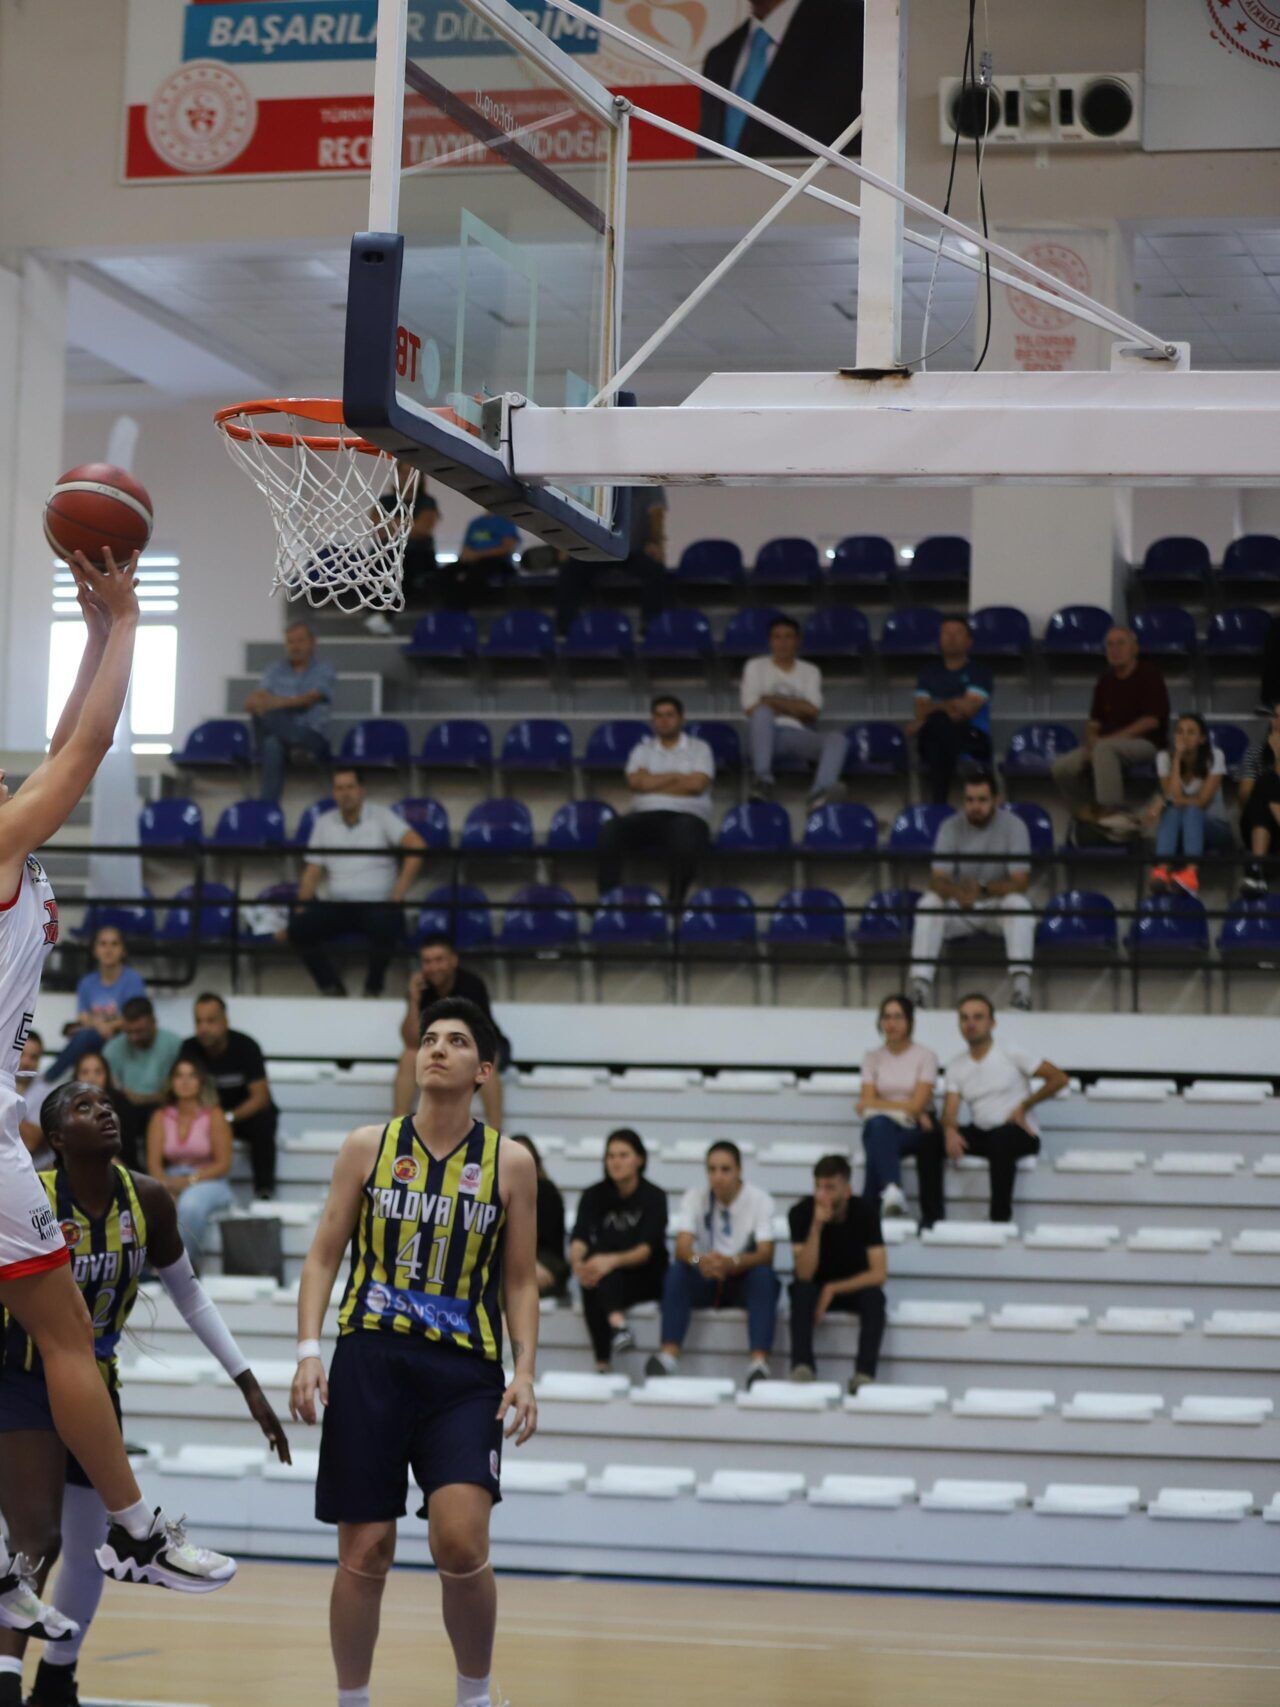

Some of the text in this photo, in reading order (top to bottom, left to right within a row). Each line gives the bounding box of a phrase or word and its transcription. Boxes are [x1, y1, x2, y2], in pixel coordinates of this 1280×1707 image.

[208, 12, 426, 54] BAŞARILR
[318, 136, 371, 168] REC
[367, 1187, 497, 1235] YALOVA VIP
[395, 1231, 447, 1285] 41
[93, 1288, 117, 1329] 2
